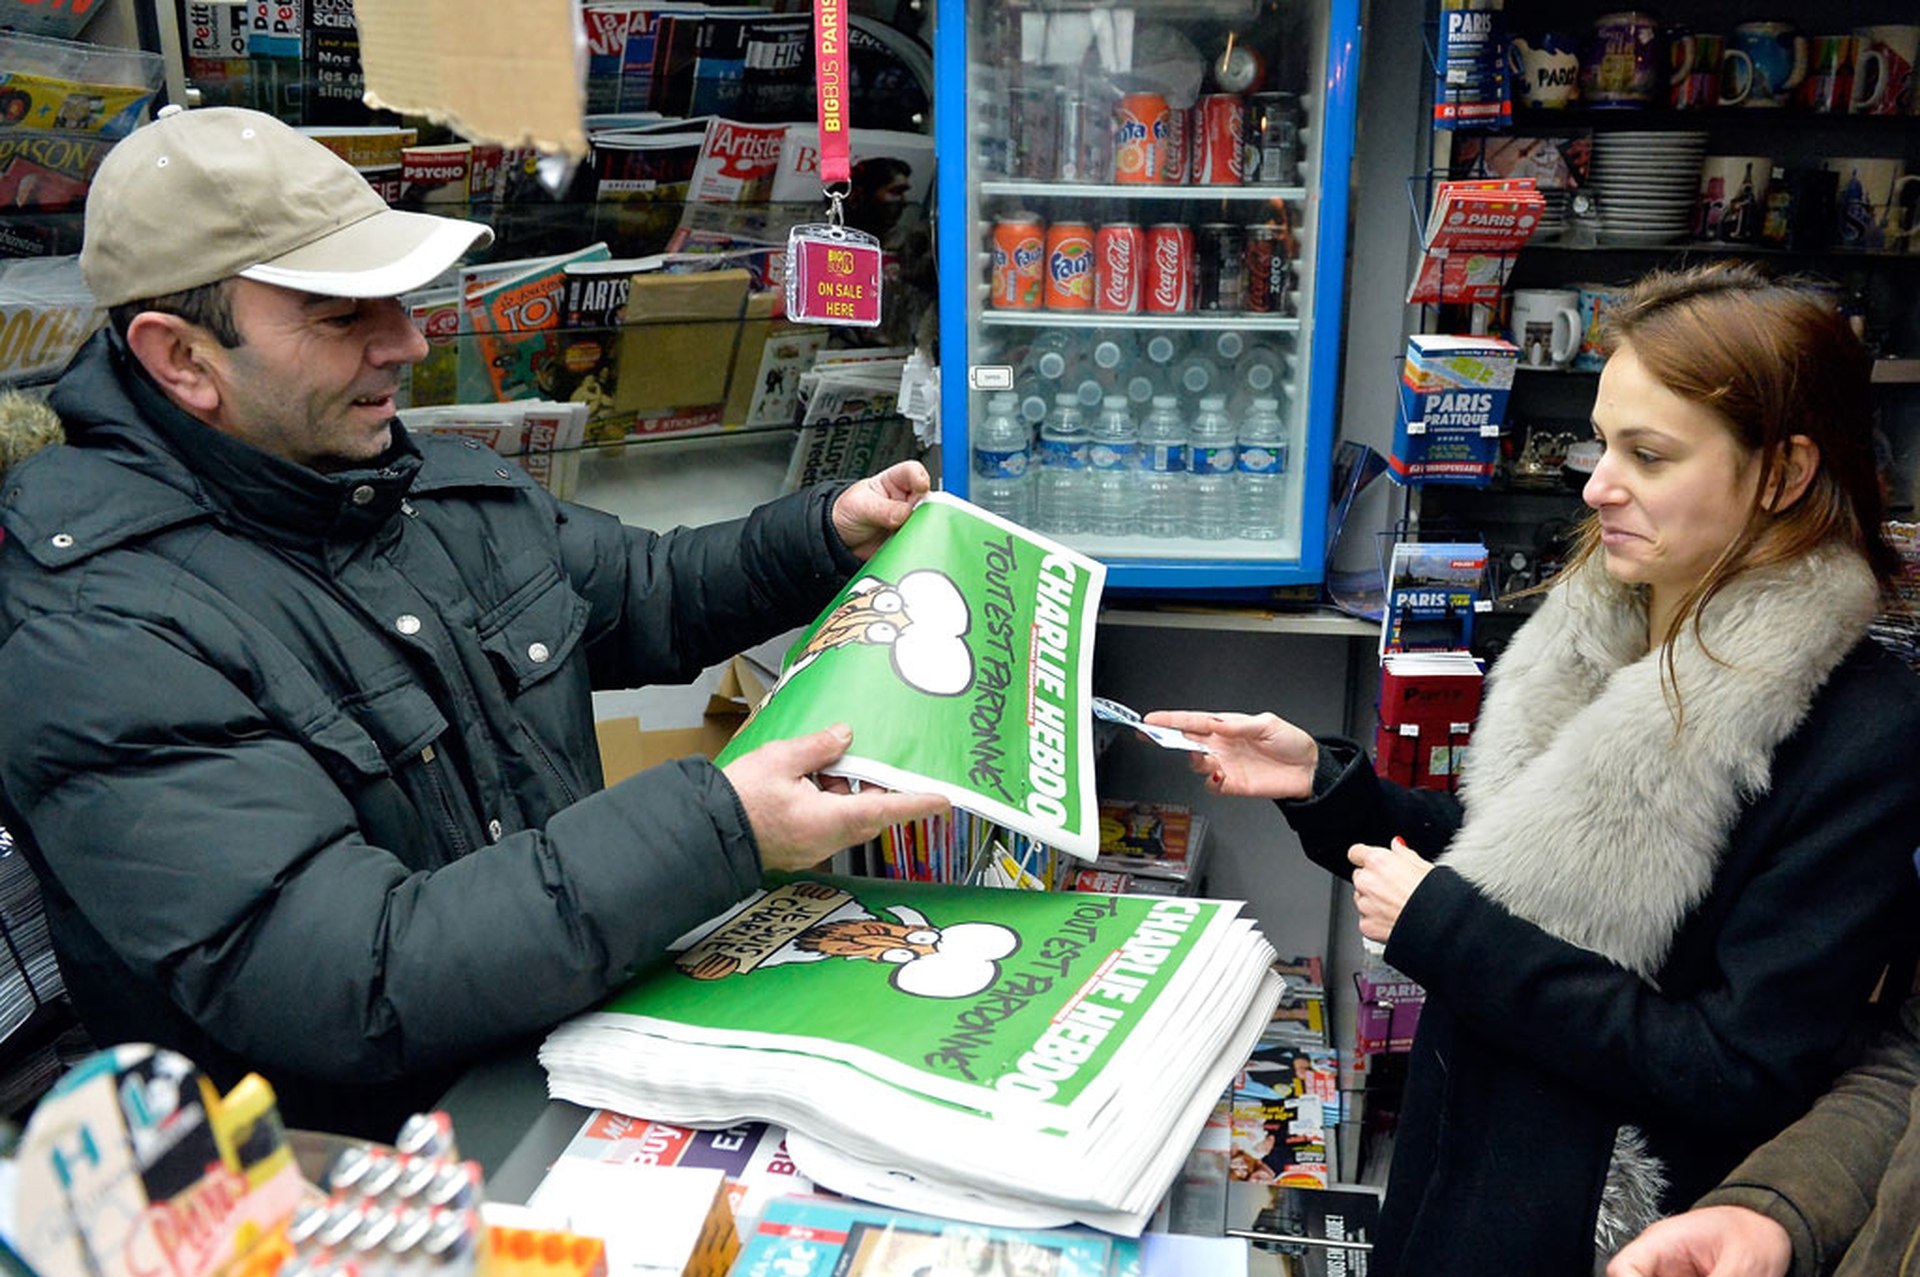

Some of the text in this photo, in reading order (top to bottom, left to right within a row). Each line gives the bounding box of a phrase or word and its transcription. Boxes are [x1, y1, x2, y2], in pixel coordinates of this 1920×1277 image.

[191, 4, 210, 50] Petit
[1448, 13, 1492, 34] PARIS
[404, 166, 464, 180] PSYCHO
[1468, 213, 1516, 228] PARIS
[818, 283, 863, 299] ON SALE
[826, 303, 855, 318] HERE
[1425, 393, 1493, 414] PARIS
[1423, 413, 1490, 427] PRATIQUE
[983, 535, 1017, 612] TOUT
[1396, 593, 1446, 607] PARIS
[1027, 553, 1077, 828] CHARLIE HEBDO
[1058, 897, 1119, 943] TOUT
[1030, 937, 1088, 978] EST
[1088, 900, 1201, 1004] CHARLIE
[1375, 984, 1427, 998] PARIS
[995, 1000, 1125, 1100] HEBDO
